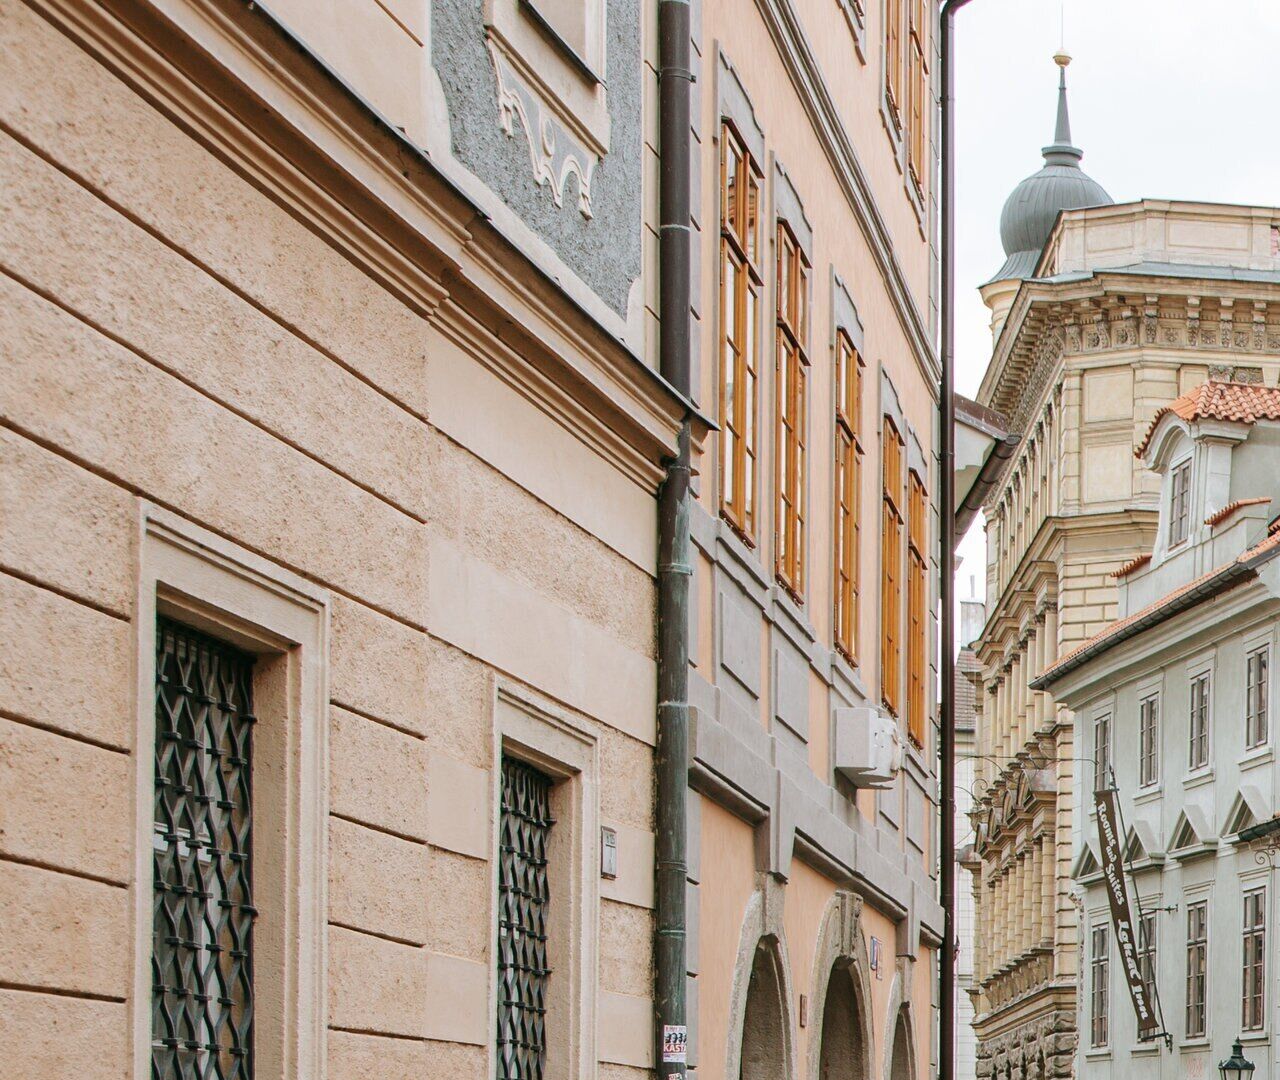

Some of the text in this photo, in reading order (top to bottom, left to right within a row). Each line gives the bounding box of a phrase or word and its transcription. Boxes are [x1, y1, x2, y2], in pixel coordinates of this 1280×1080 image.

[1098, 801, 1124, 905] Rooms and Suites
[1131, 985, 1148, 1020] Inn
